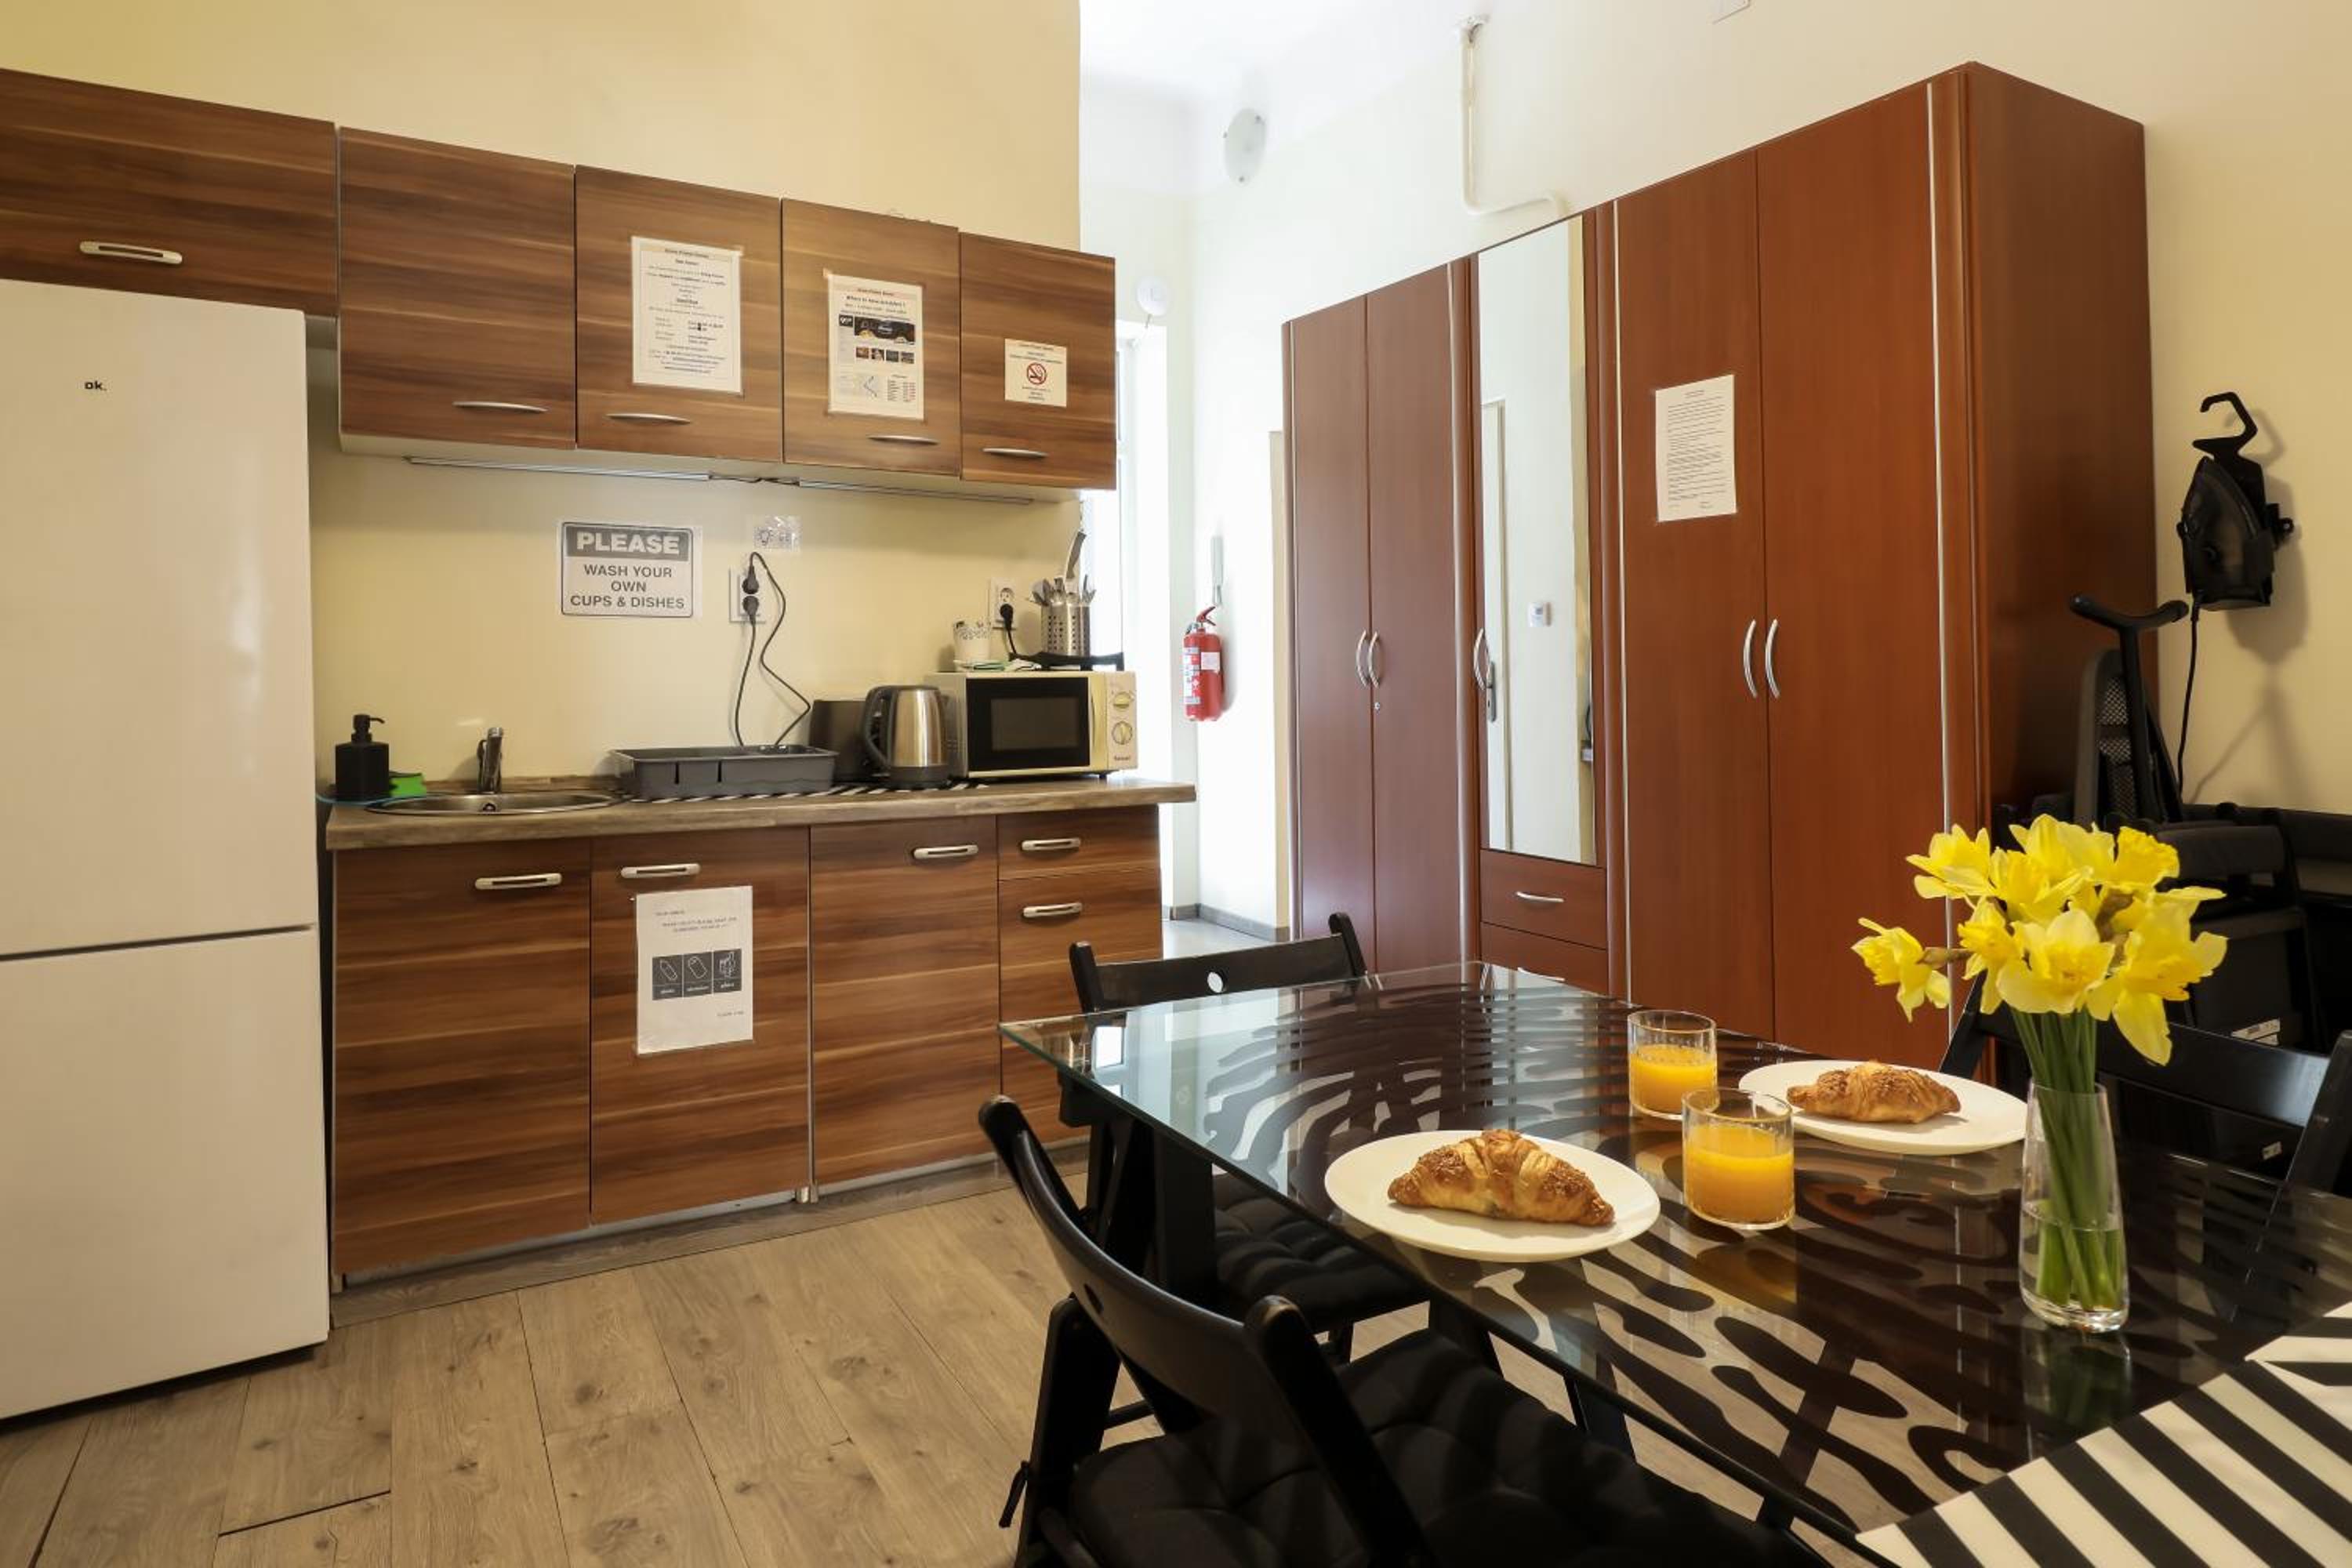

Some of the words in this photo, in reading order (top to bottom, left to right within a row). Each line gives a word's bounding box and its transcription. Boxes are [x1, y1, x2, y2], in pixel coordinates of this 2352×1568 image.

[576, 532, 680, 555] PLEASE
[584, 564, 628, 576] WASH
[633, 566, 672, 578] YOUR
[611, 581, 647, 592] OWN
[570, 595, 612, 607] CUPS
[617, 597, 626, 608] &
[631, 597, 684, 609] DISHES
